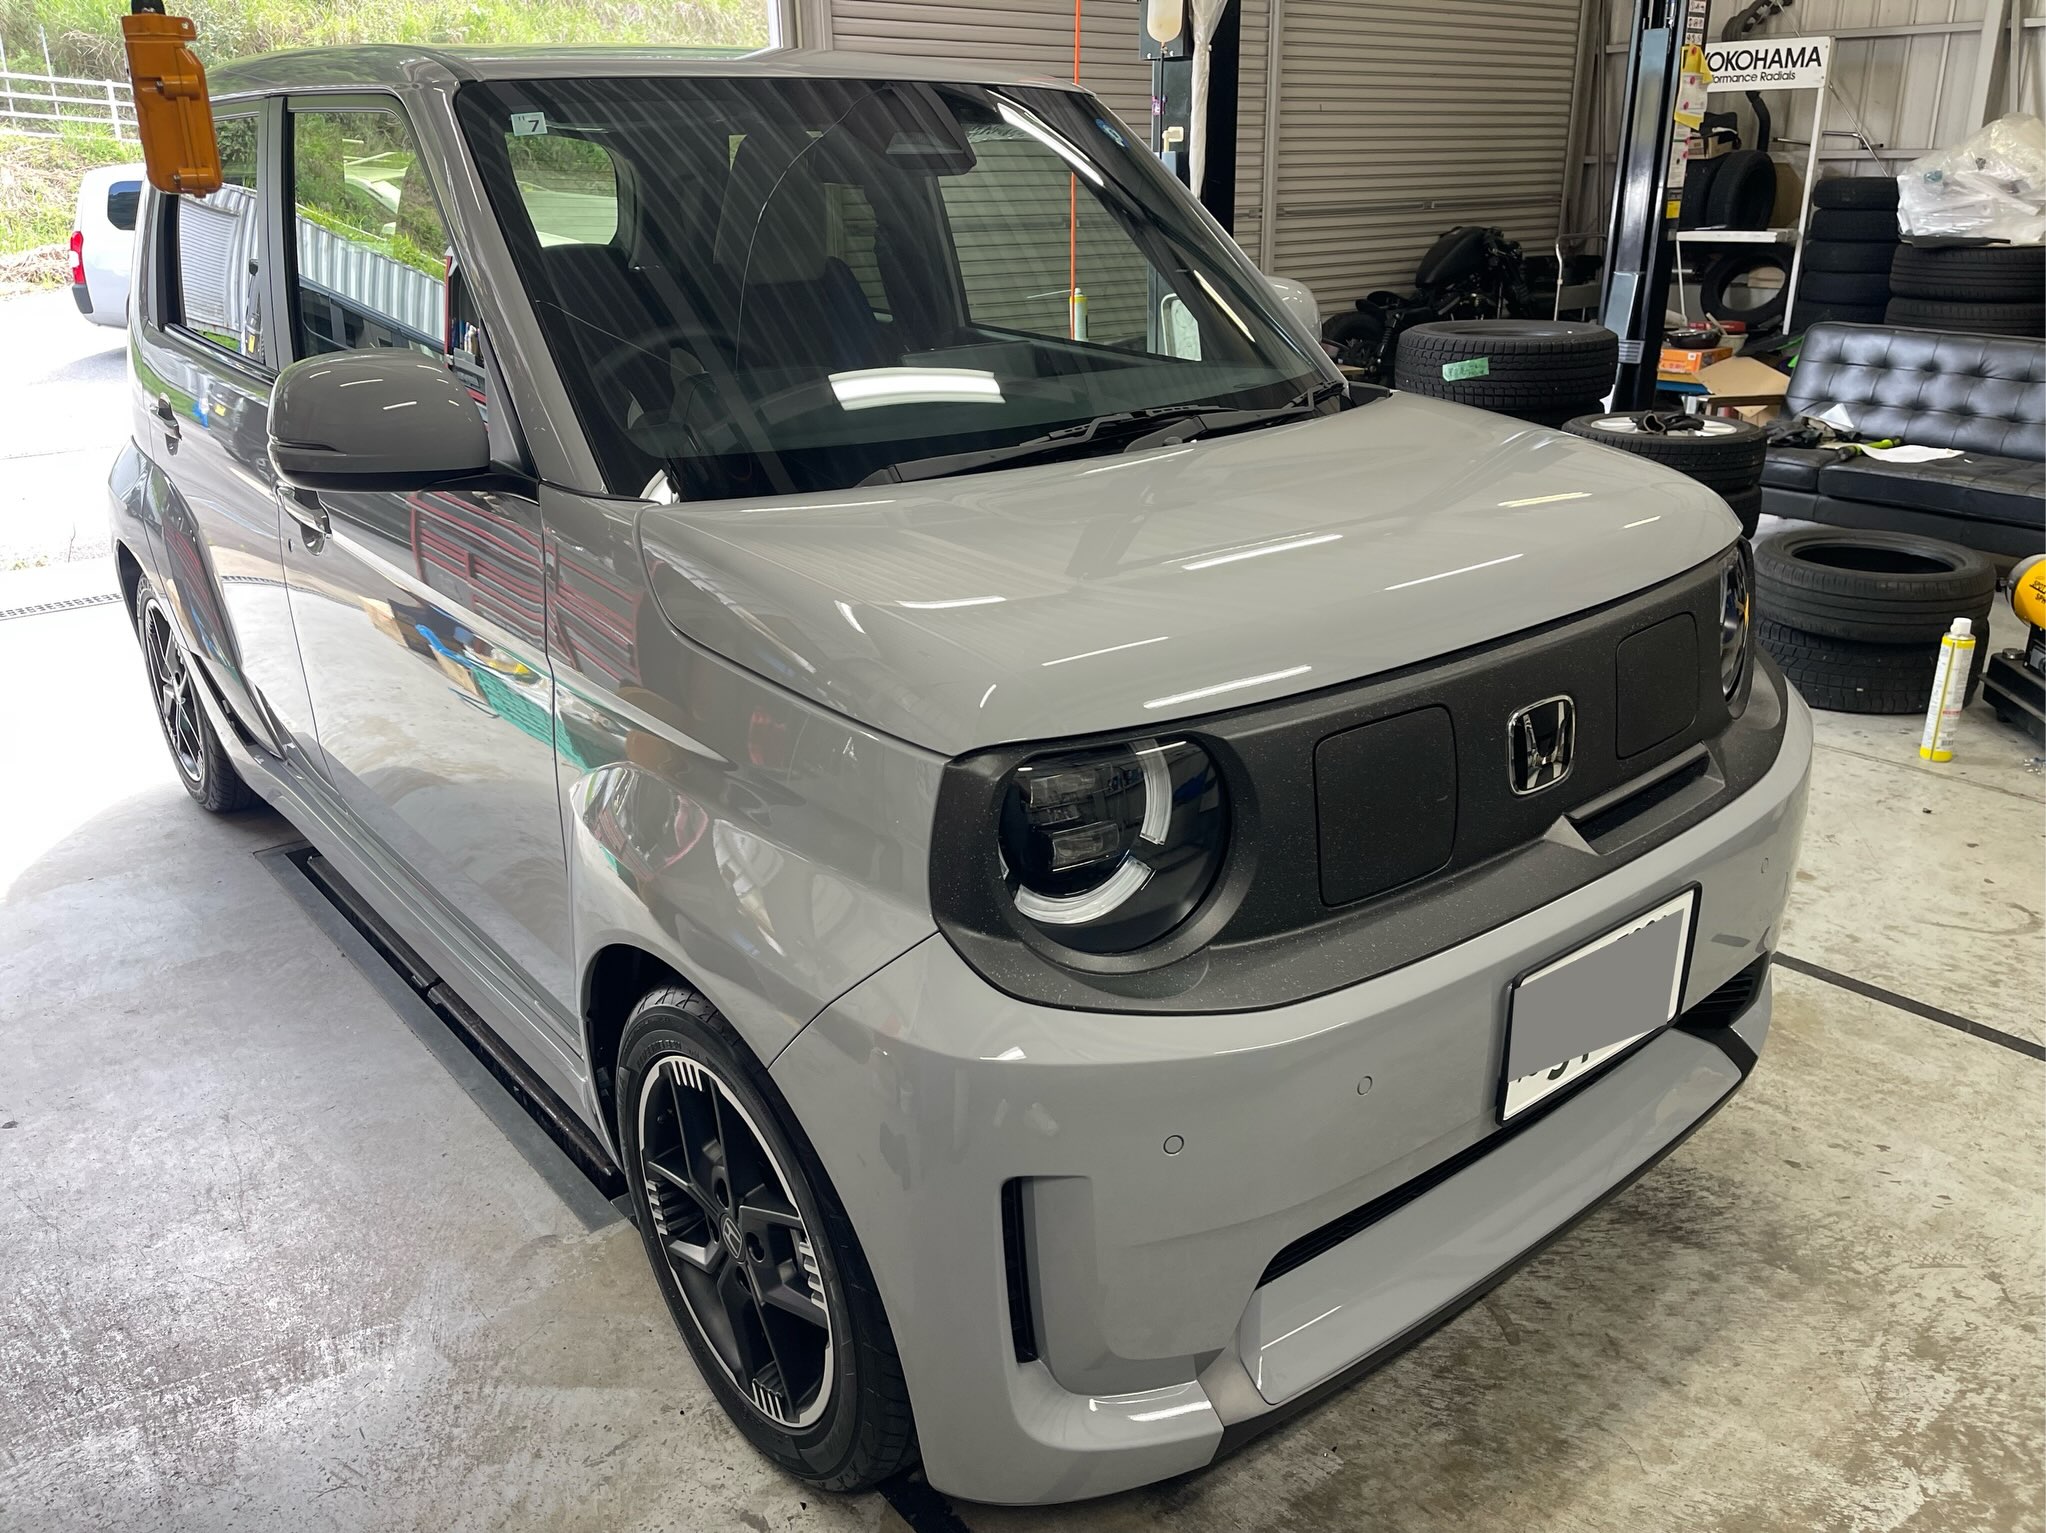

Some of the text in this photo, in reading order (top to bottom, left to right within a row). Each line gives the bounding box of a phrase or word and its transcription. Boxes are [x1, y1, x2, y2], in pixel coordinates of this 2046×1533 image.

[1712, 70, 1796, 84] ormance Radials
[528, 119, 540, 133] 7
